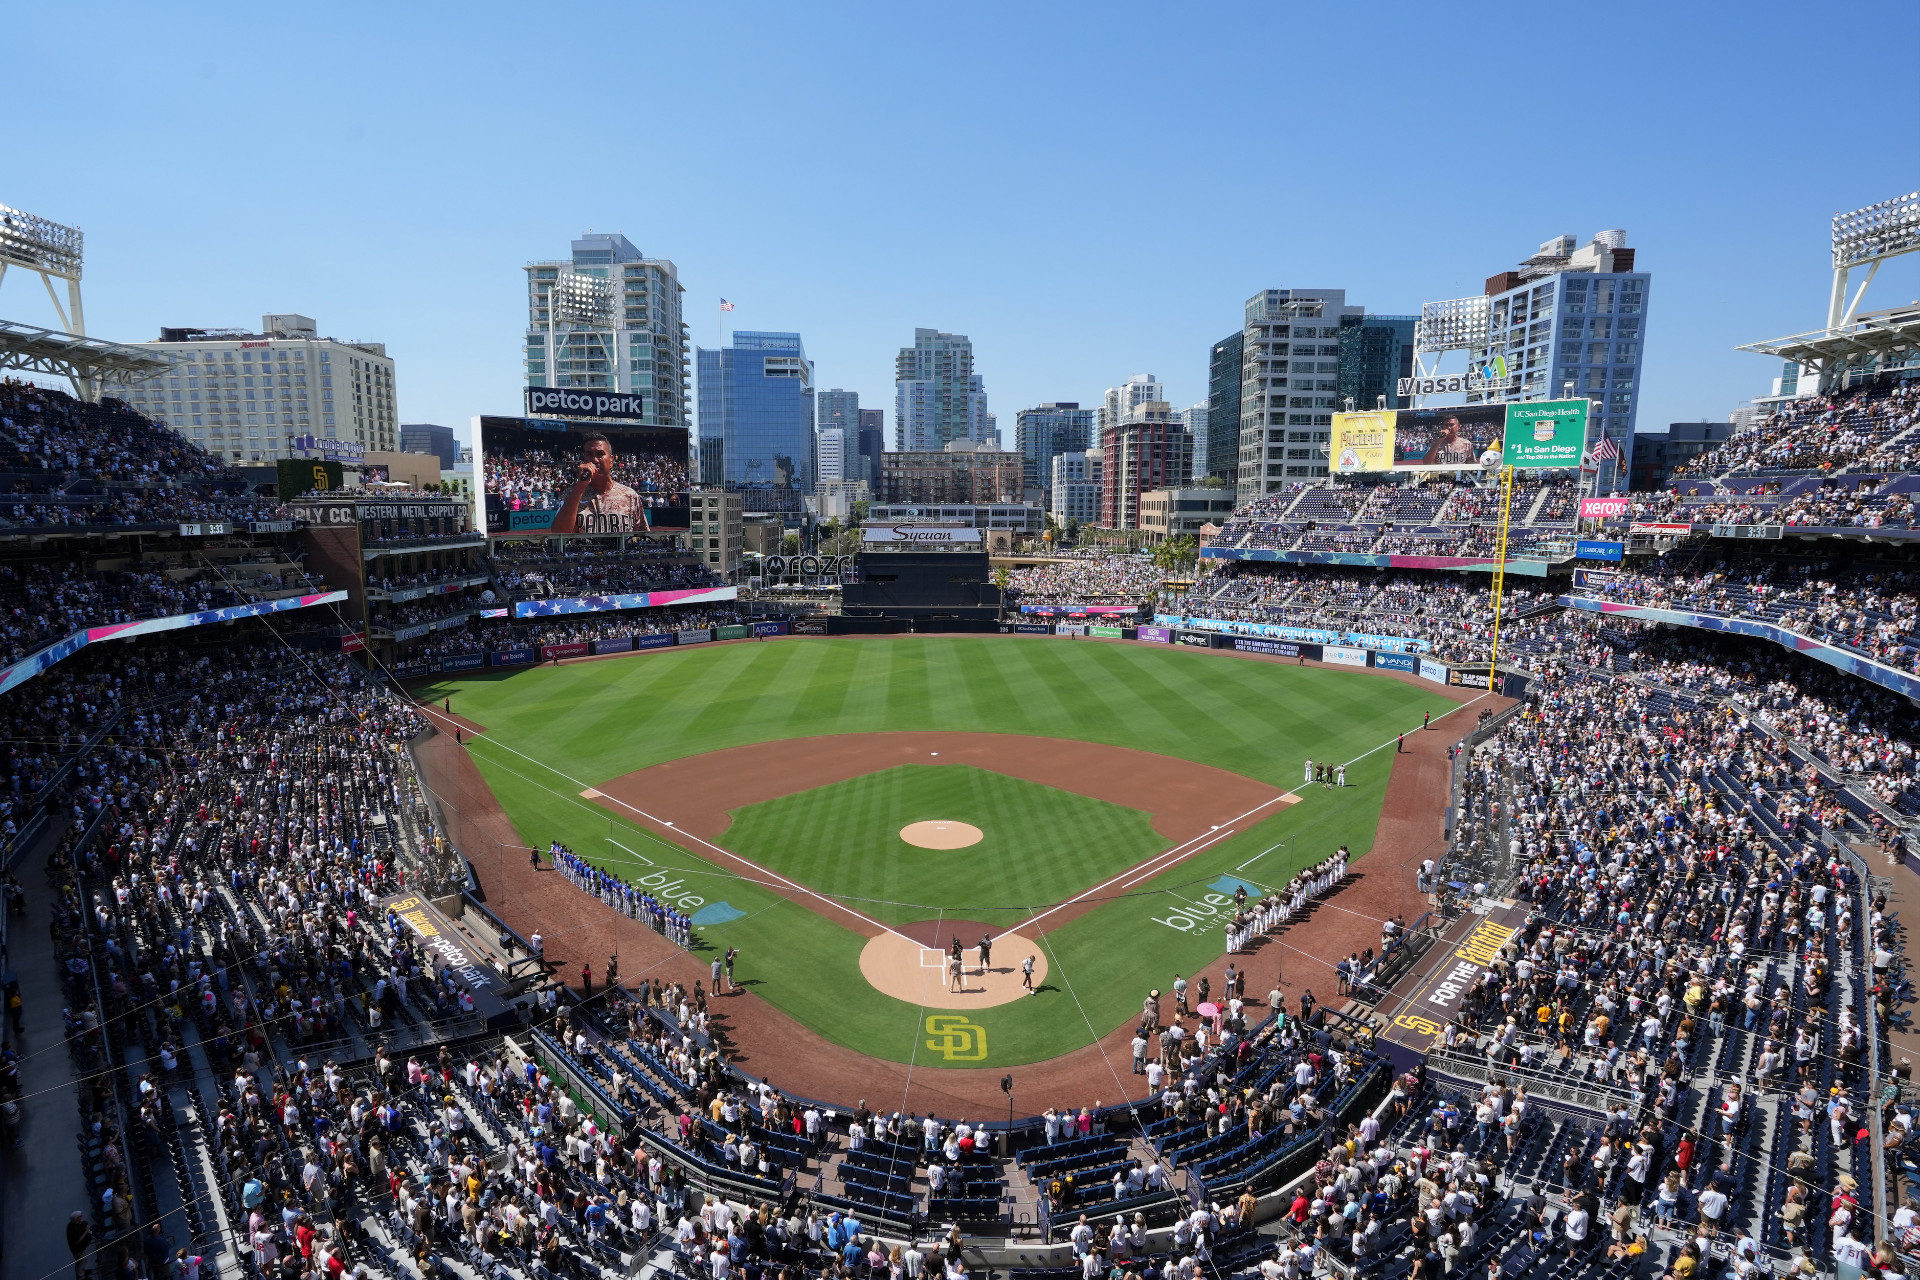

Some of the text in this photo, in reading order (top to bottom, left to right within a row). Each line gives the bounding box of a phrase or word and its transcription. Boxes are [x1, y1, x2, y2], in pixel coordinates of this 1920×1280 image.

[240, 341, 270, 349] Marriott
[1400, 373, 1473, 395] Viasat
[531, 390, 641, 416] petco park
[1514, 408, 1580, 418] UC San Diego Health
[1533, 445, 1550, 453] San
[1551, 444, 1577, 453] Diego
[356, 505, 470, 519] WESTERN METAL SUPPLY CO.
[1585, 501, 1623, 515] xerox
[512, 513, 550, 526] petco
[209, 523, 225, 535] 3:33
[891, 523, 954, 544] Sycuan
[1747, 526, 1767, 538] 3:33
[755, 625, 778, 634] ARCO
[429, 663, 441, 672] 342
[454, 658, 482, 667] Palomar
[1421, 664, 1437, 676] petco
[636, 869, 705, 909] blue
[1150, 893, 1234, 933] blue
[427, 941, 468, 966] petco
[452, 963, 492, 990] park
[1428, 960, 1480, 1007] FOR THE
[925, 1015, 988, 1061] SD
[1421, 1185, 1431, 1194] 23
[256, 1242, 265, 1252] 12
[1848, 1249, 1860, 1259] 51
